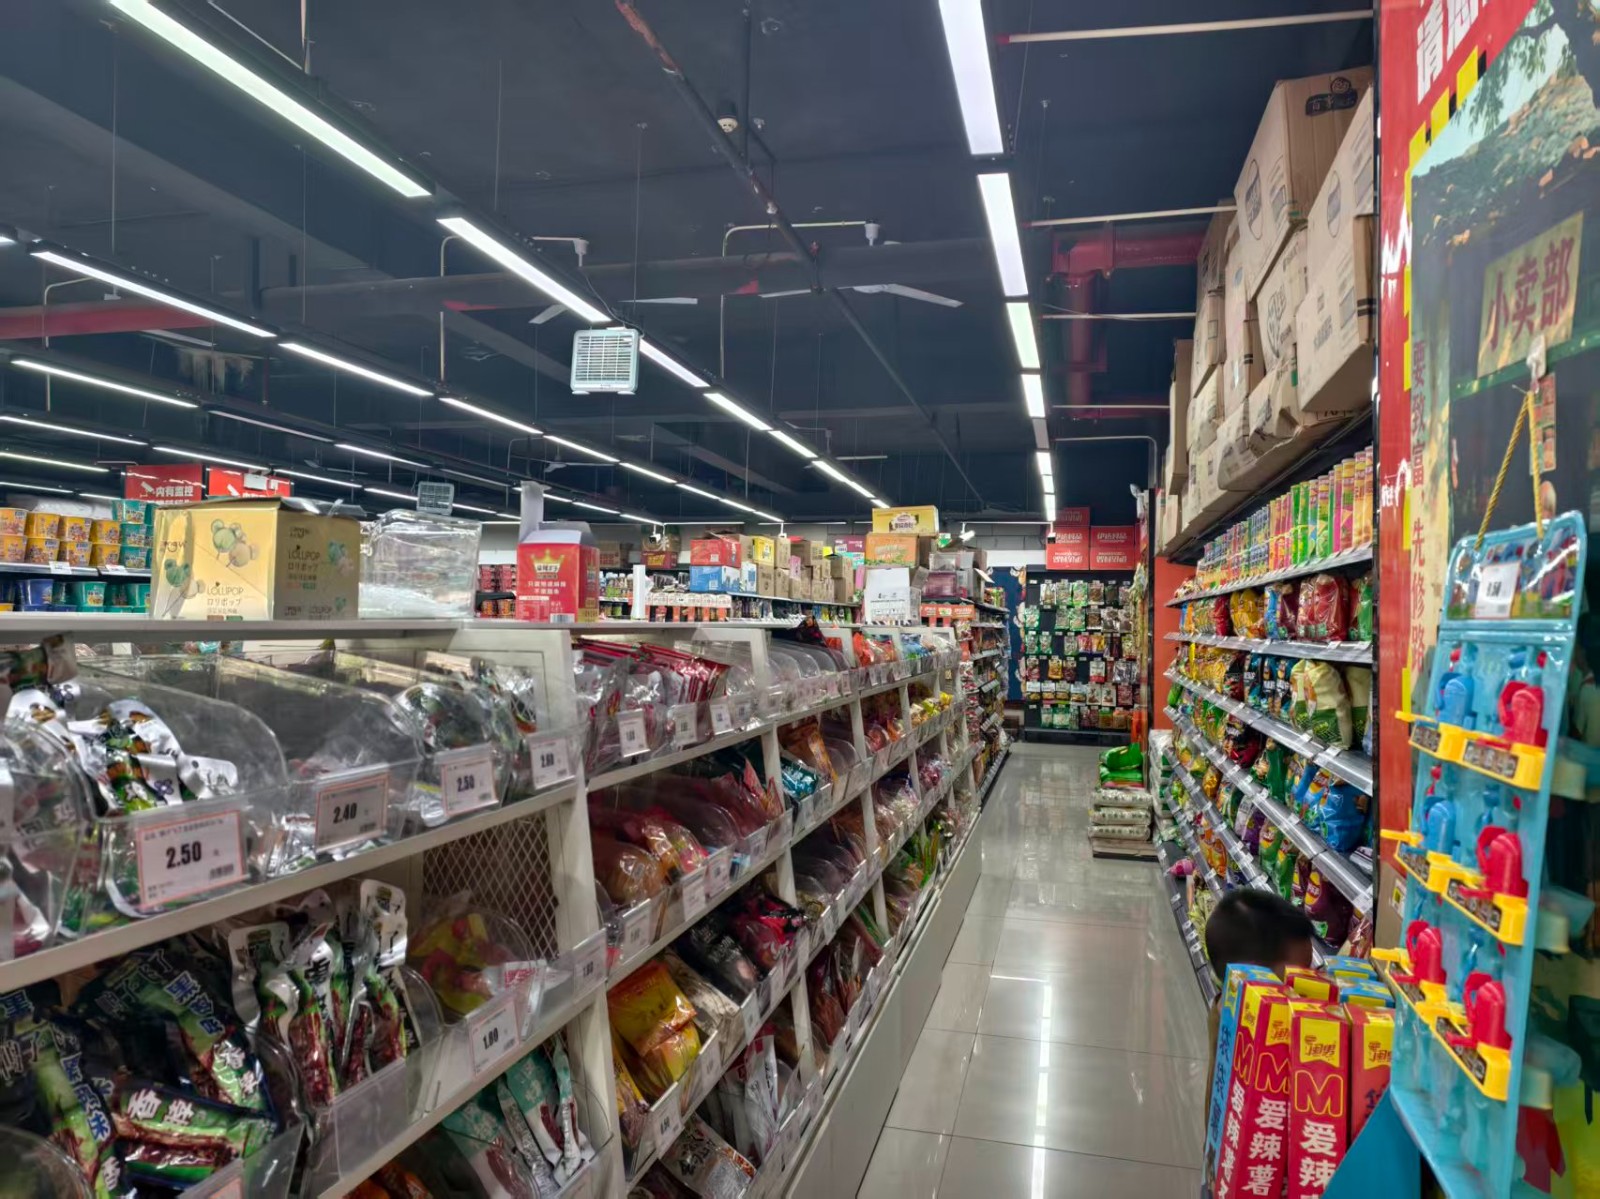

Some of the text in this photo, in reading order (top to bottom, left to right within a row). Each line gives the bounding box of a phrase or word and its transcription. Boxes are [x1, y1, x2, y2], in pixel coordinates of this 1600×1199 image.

[1486, 237, 1574, 352] 小卖部
[155, 486, 193, 497] 内有监控
[207, 586, 244, 596] LOLLIPOP
[457, 774, 475, 793] 2.50
[333, 802, 358, 824] 2.40
[166, 841, 202, 869] 2.50
[1255, 1052, 1290, 1093] M
[1294, 1069, 1344, 1117] M
[1241, 1096, 1287, 1196] 爱辣薯
